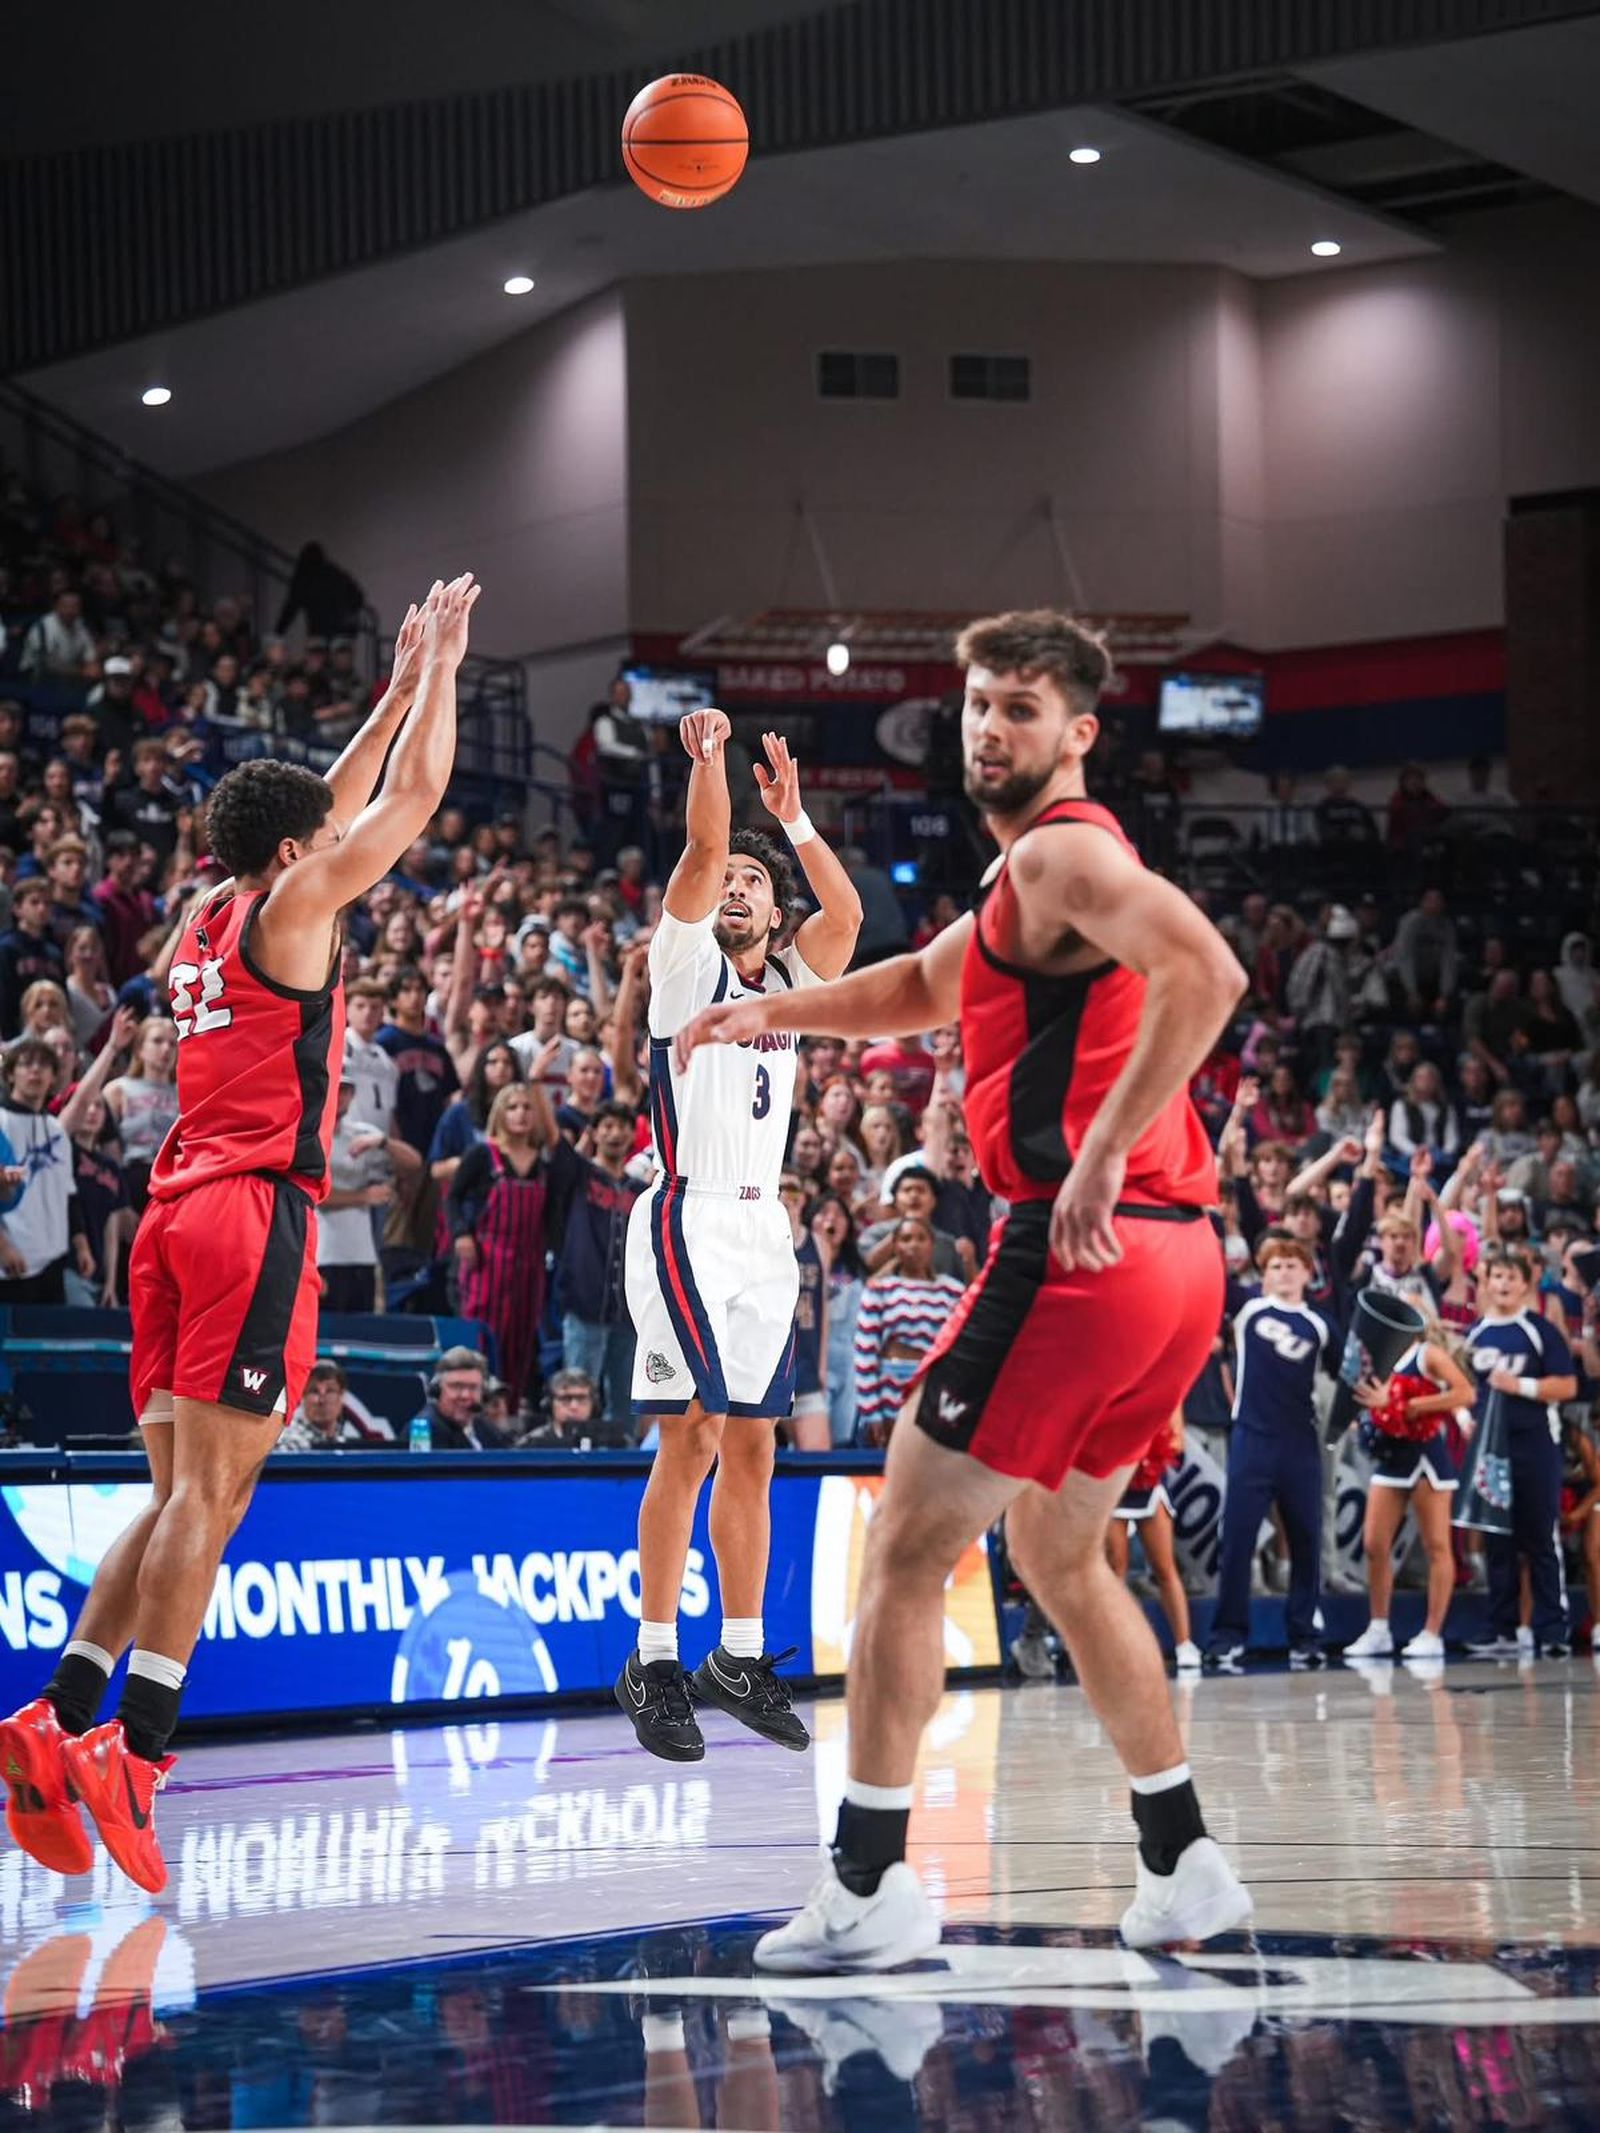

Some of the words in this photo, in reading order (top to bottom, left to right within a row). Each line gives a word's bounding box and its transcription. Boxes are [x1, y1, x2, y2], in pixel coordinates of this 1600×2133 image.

[373, 1083, 382, 1110] 1
[752, 1064, 771, 1120] 3
[739, 1186, 761, 1200] ZAGS
[242, 1367, 268, 1391] W
